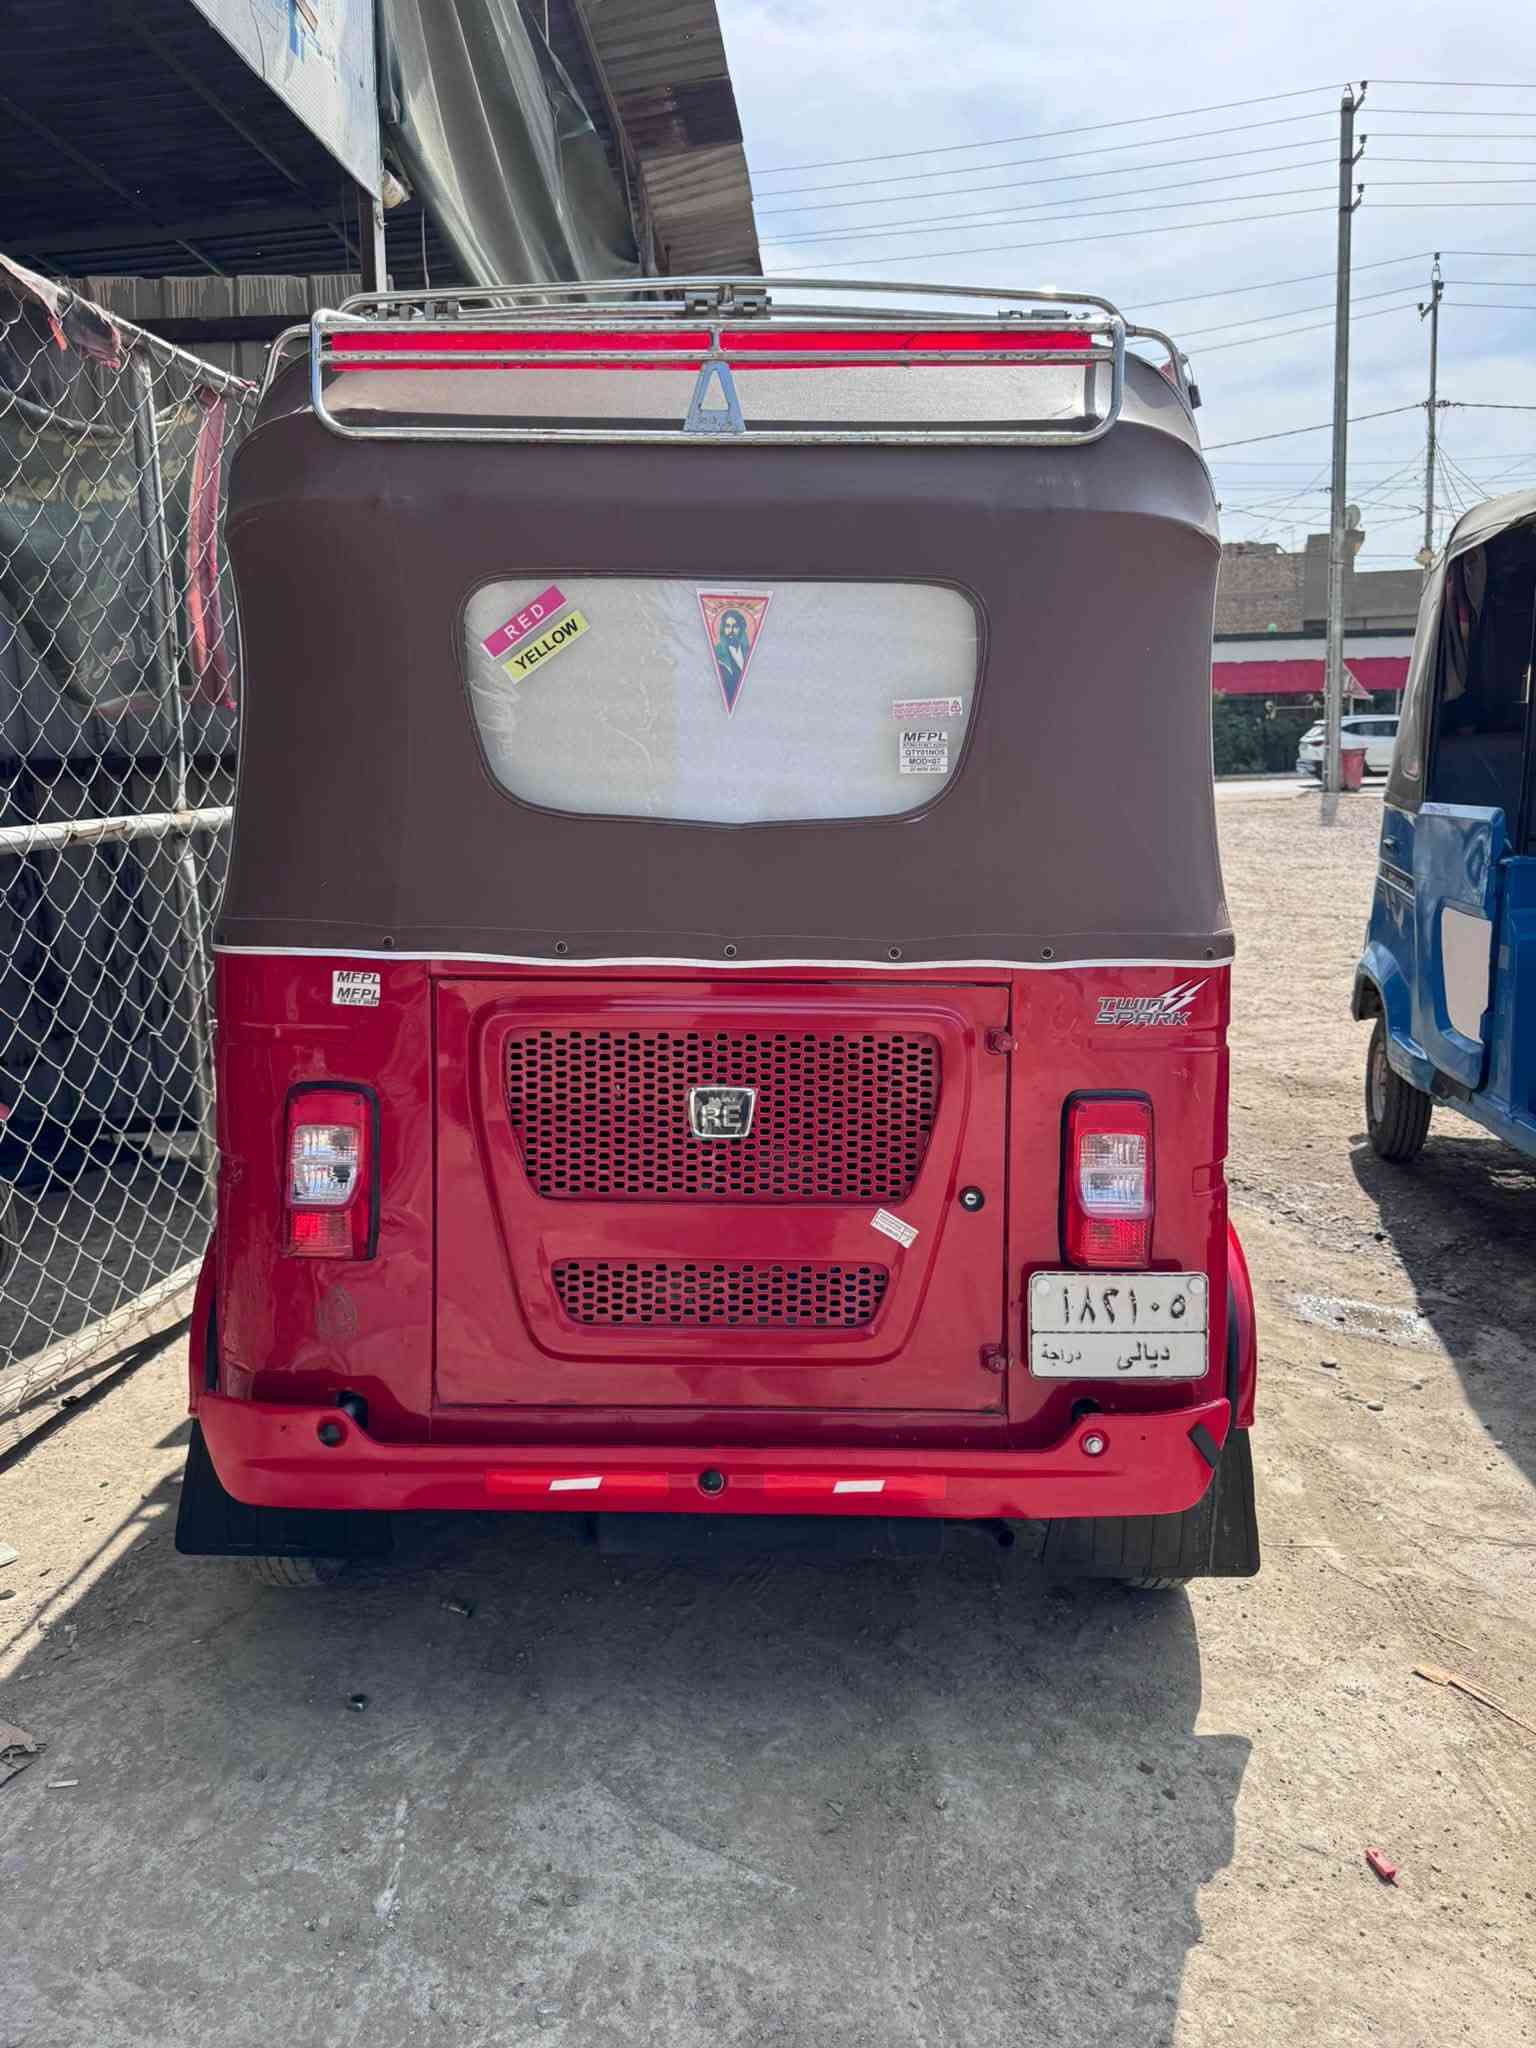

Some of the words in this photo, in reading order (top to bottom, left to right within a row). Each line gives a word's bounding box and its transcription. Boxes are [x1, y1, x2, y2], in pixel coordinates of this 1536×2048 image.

[504, 604, 544, 639] RED
[514, 618, 578, 670] YELLOW
[904, 732, 945, 742] MFPL
[337, 972, 380, 984] MFPL
[337, 987, 380, 1000] MFPL
[1098, 996, 1165, 1011] TWIN
[1094, 1011, 1192, 1026] SPARK
[702, 1104, 741, 1128] RE
[1041, 1343, 1082, 1366] دراجة
[1116, 1341, 1170, 1371] ديالى
